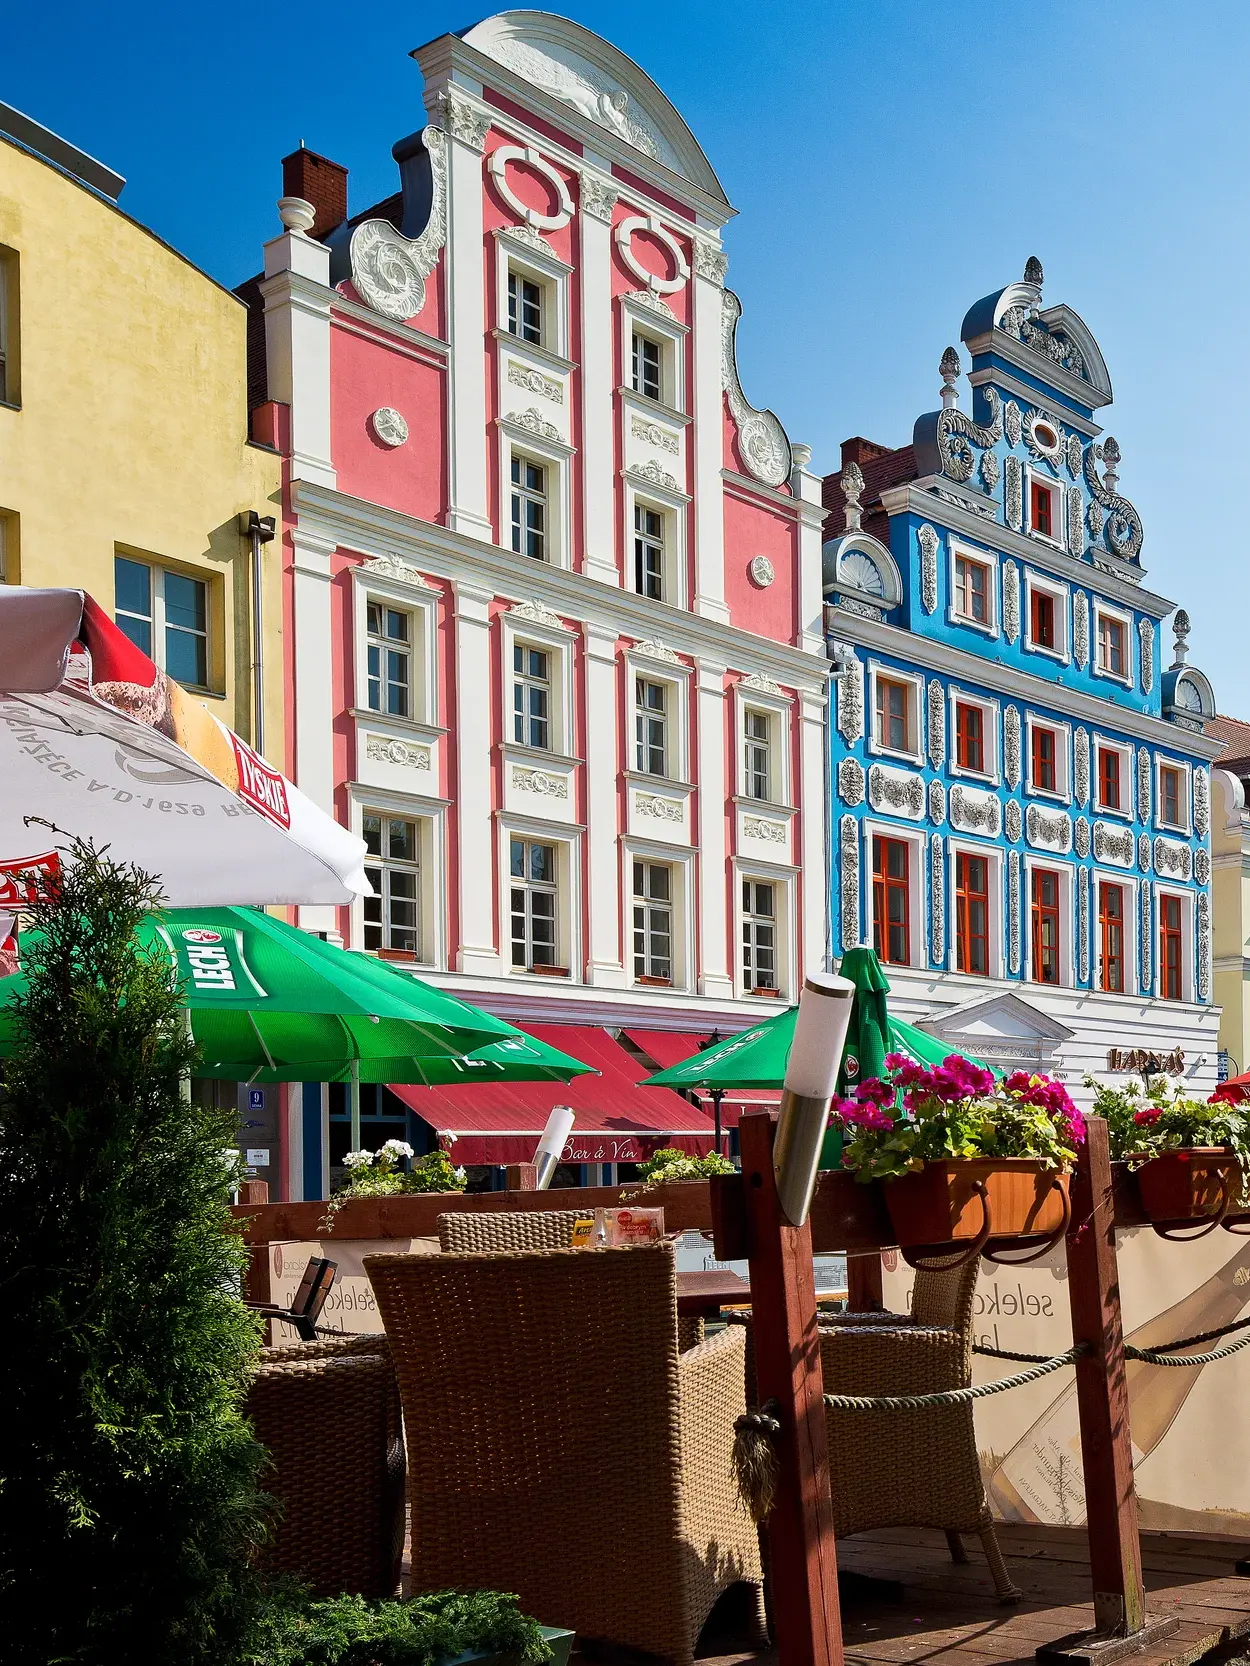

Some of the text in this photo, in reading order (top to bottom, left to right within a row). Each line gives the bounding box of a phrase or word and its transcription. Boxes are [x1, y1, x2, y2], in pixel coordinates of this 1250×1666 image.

[239, 746, 289, 821] TYSKIE
[186, 945, 236, 990] LECH
[253, 1092, 260, 1103] 9
[560, 1137, 591, 1160] Bar
[610, 1138, 638, 1159] Vin
